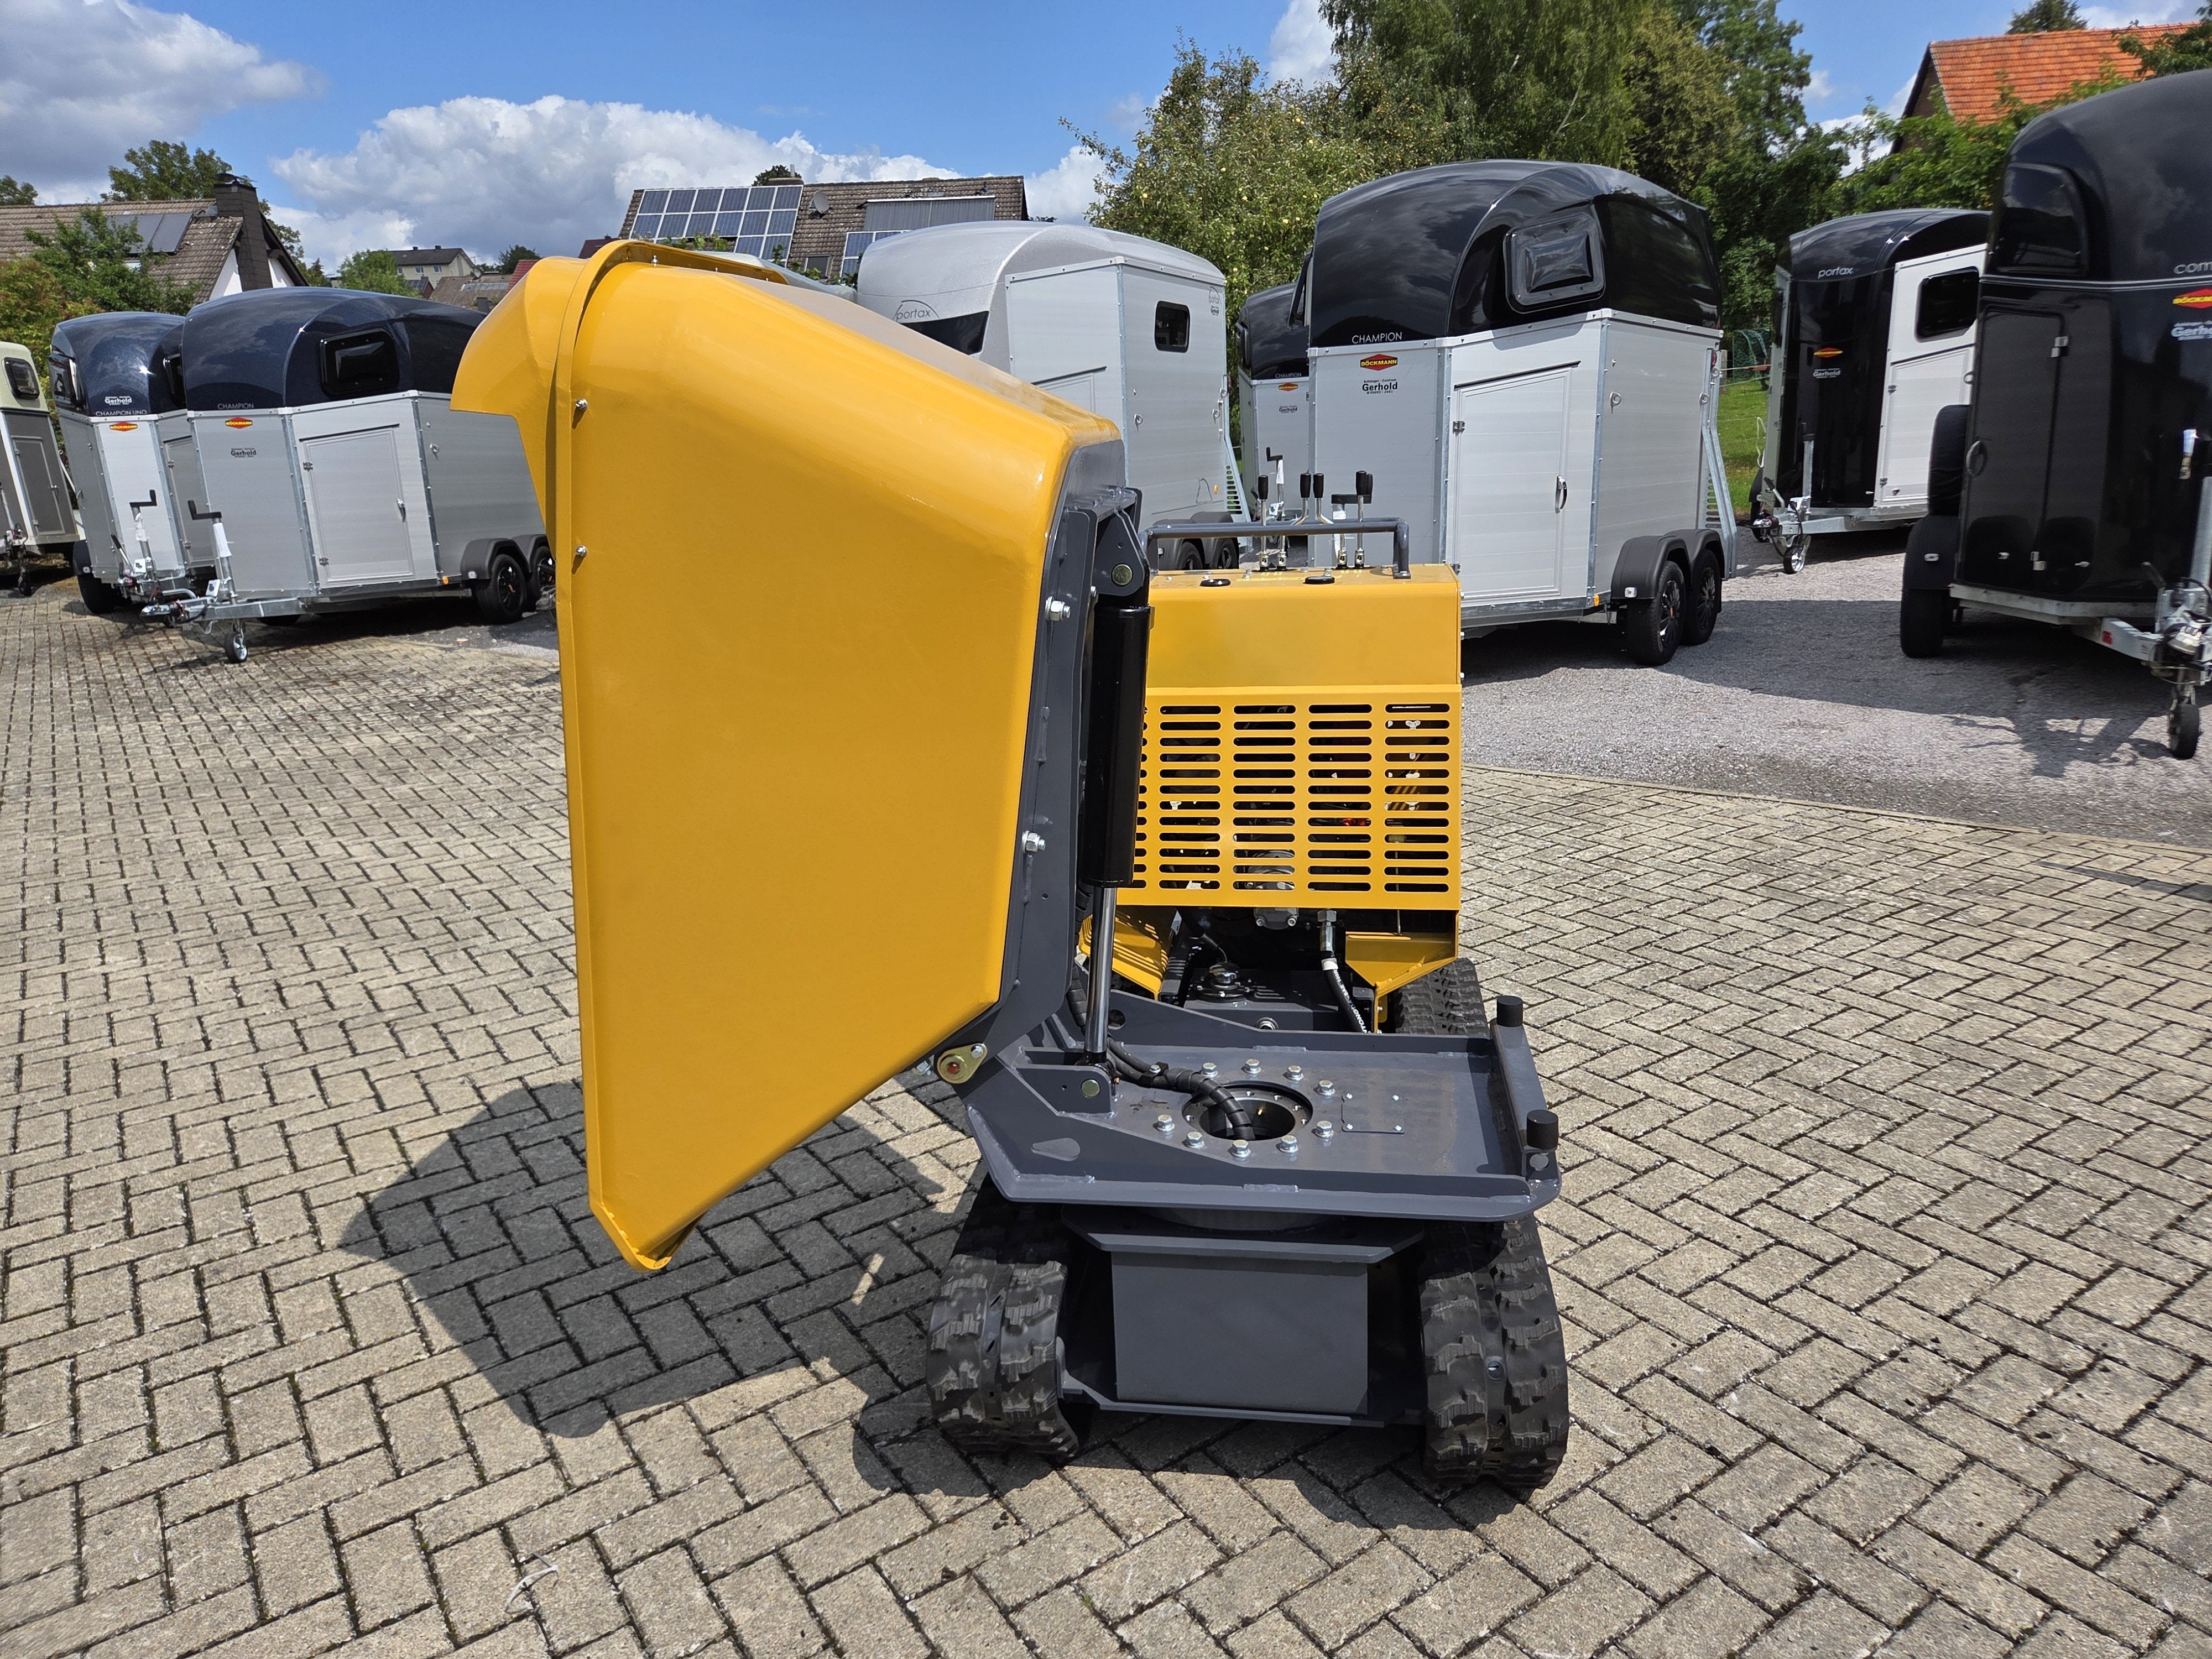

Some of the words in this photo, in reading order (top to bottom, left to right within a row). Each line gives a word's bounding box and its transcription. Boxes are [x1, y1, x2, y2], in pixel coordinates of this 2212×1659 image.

[1818, 265, 1854, 279] portax
[896, 308, 931, 322] portax
[1352, 332, 1402, 344] CHAMPION
[1362, 382, 1398, 392] Gerhold
